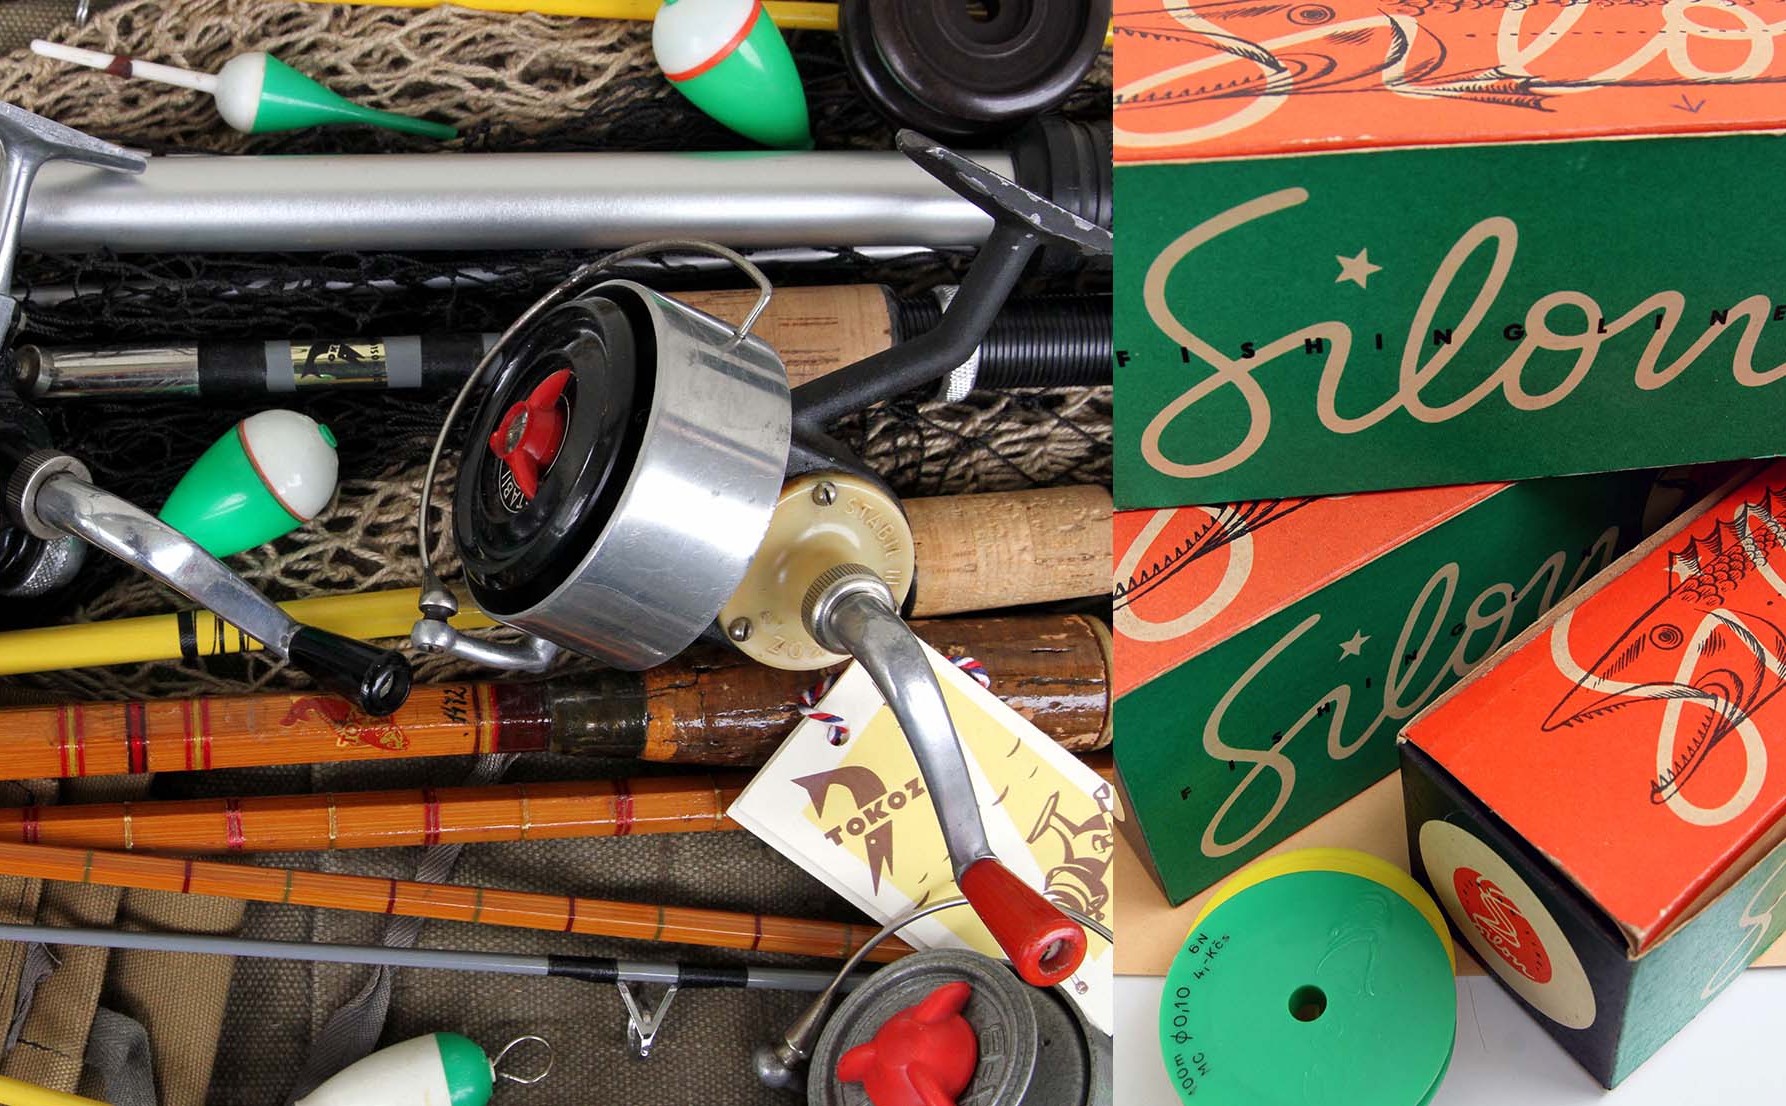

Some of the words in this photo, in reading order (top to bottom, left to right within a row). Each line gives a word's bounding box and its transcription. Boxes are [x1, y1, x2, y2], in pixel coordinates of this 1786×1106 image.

[1116, 322, 1525, 368] FISHING
[1140, 187, 1786, 479] Silon
[845, 497, 902, 558] STABIL
[824, 777, 926, 846] TOKOZ
